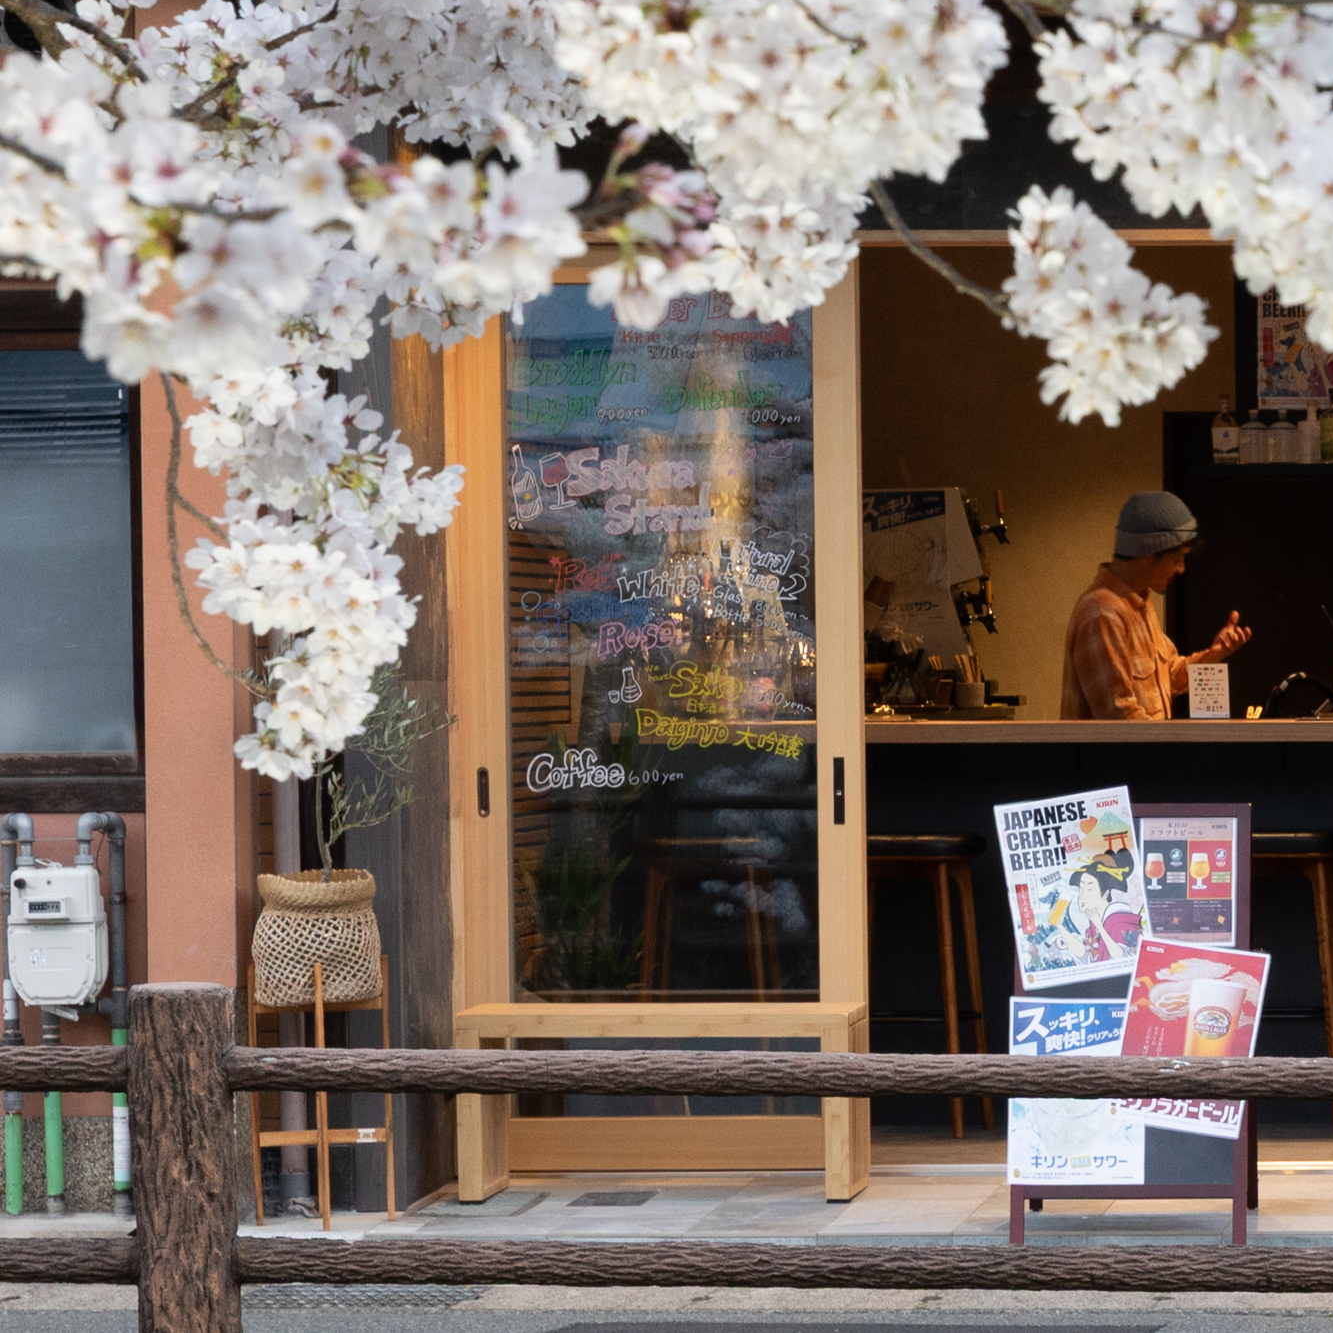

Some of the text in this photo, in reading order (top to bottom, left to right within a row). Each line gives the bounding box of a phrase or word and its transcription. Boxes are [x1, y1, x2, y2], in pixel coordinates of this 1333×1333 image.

[566, 444, 696, 497] Sakura
[604, 482, 716, 535] Stand
[617, 566, 700, 604] White
[669, 660, 743, 702] Sake
[526, 748, 684, 793] Coffee 600yen
[1003, 801, 1088, 832] JAPANESE
[1096, 799, 1119, 808] KIRIN
[1007, 826, 1063, 852] CRAFT
[1149, 829, 1204, 837] クラフトビール
[1009, 846, 1068, 872] BEER!!
[1146, 945, 1165, 954] KIRIN
[1016, 1007, 1100, 1042] スッキリ、
[1045, 1028, 1086, 1053] 爽快!
[1031, 1155, 1068, 1169] キリン
[1092, 1155, 1128, 1169] サワー
